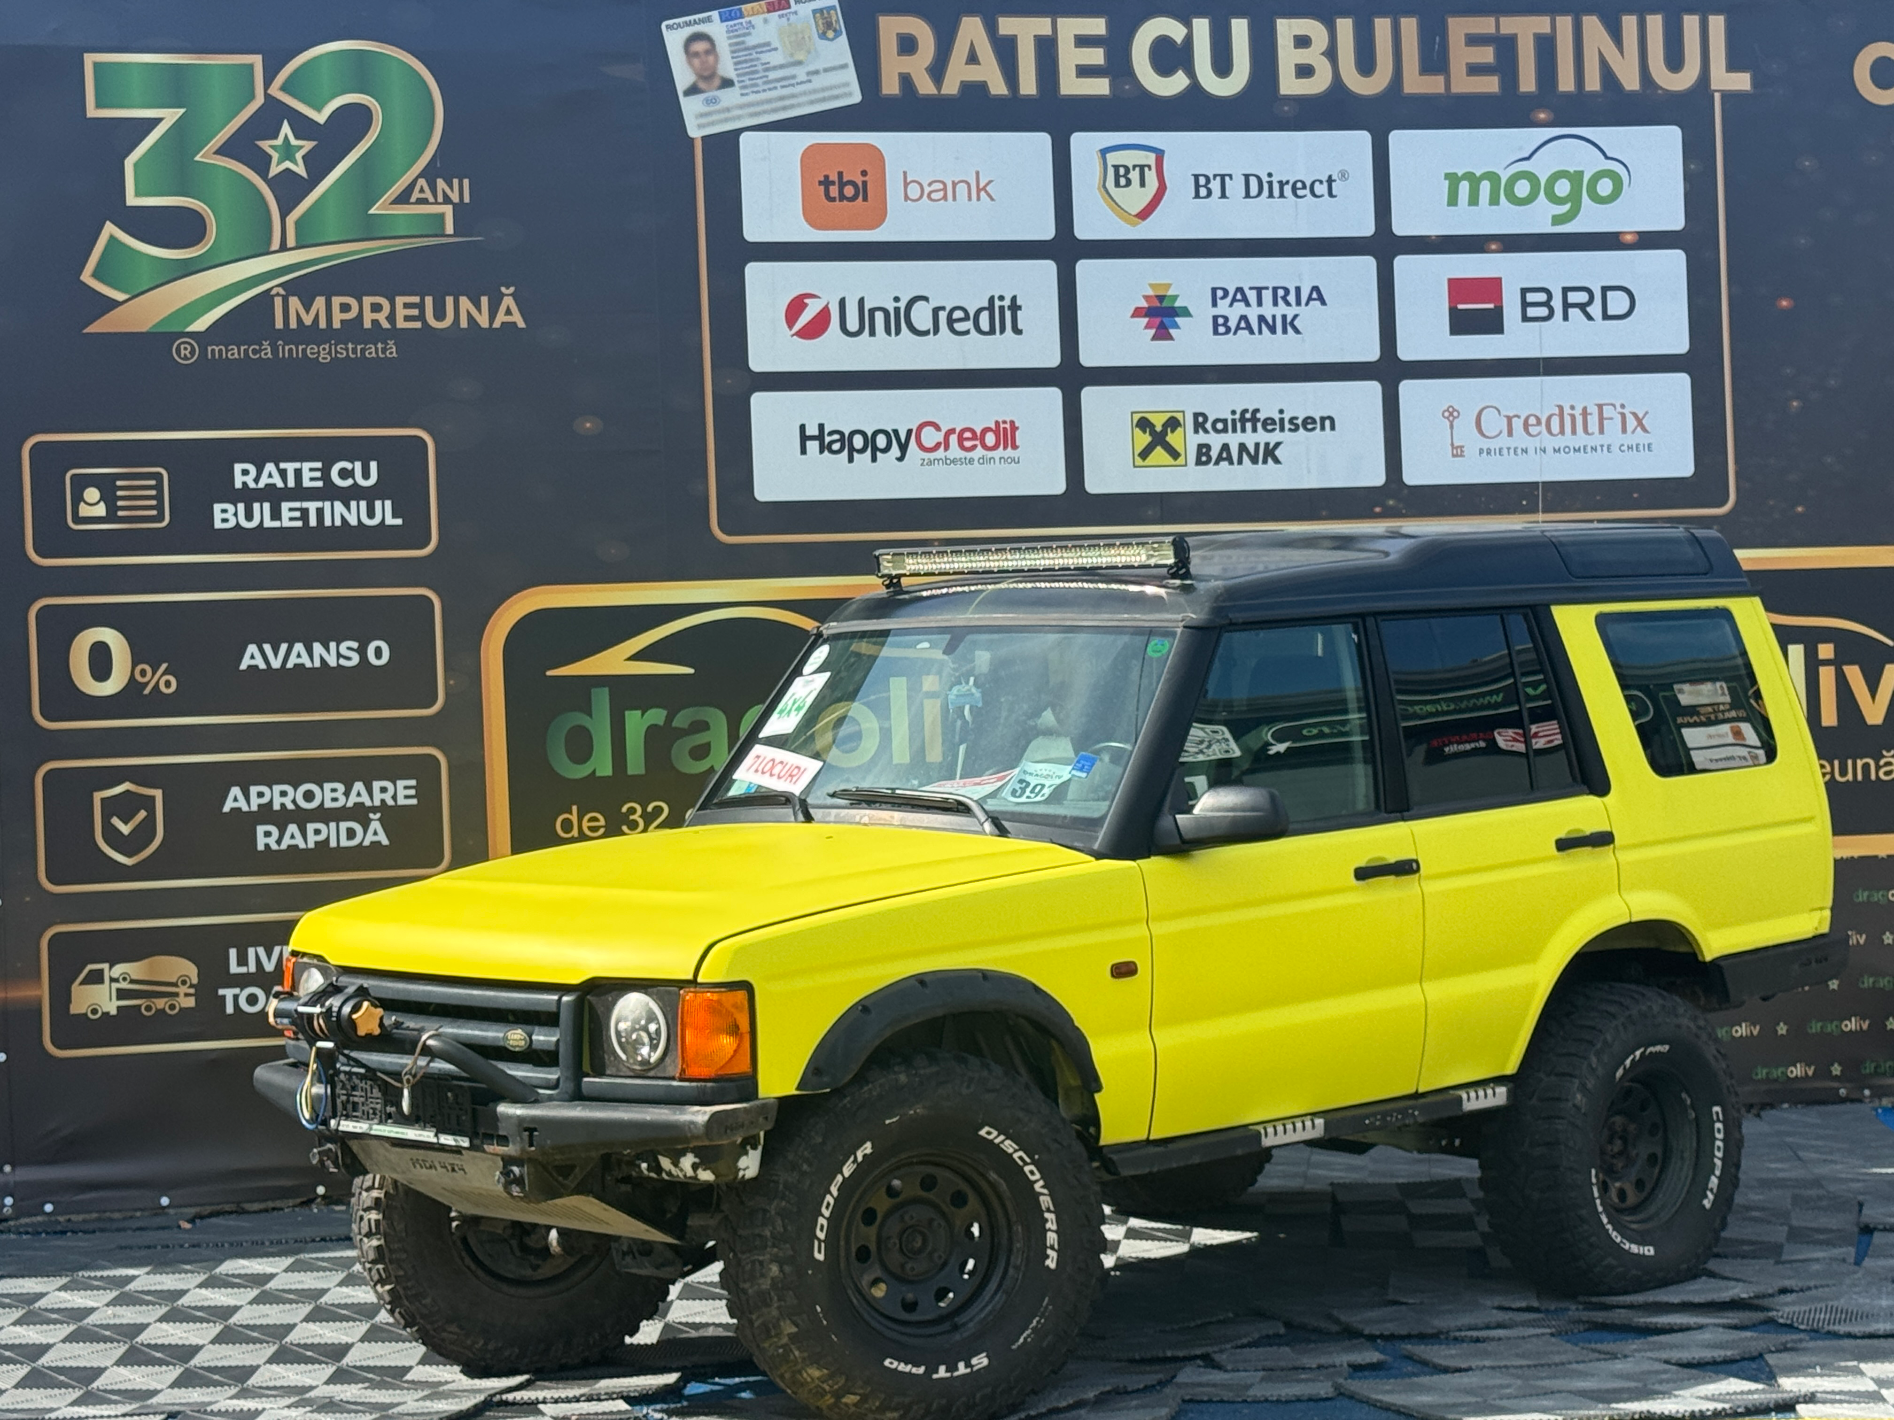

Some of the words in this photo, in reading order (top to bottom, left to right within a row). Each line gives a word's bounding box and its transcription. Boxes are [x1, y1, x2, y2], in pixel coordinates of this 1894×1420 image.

[665, 15, 714, 32] ROUMANIE
[877, 15, 1111, 97] RATE
[1131, 15, 1251, 97] CU
[1276, 13, 1752, 96] BULETINUL
[1853, 41, 1894, 106] C
[409, 177, 471, 204] ANI
[817, 169, 869, 203] tbi
[902, 169, 997, 203] bank
[1111, 164, 1152, 189] BT
[1191, 173, 1234, 200] BT
[1443, 167, 1625, 227] mogo
[270, 286, 526, 331] ÎMPREUNĂ
[1210, 285, 1328, 308] PATRIA
[1519, 284, 1637, 324] BRD
[838, 294, 1024, 339] UniCredit
[1212, 313, 1304, 336] BANK
[206, 340, 272, 361] marcă
[277, 338, 398, 363] înregistrată
[1192, 407, 1336, 435] Raiffeisen
[1474, 402, 1651, 440] CreditFix
[799, 419, 1020, 464] HappyCredit
[1194, 441, 1284, 467] BANK
[1478, 446, 1529, 458] PRIETEN
[1534, 446, 1547, 456] IN
[1552, 443, 1613, 456] MOMENTE
[1618, 442, 1654, 454] CHEIE
[233, 462, 323, 489] RATE
[330, 461, 379, 488] CU
[919, 455, 975, 467] zambeste
[977, 453, 996, 466] din
[998, 455, 1021, 465] nou
[212, 500, 403, 530] BULETINUL
[239, 641, 360, 671] AVANS
[366, 640, 391, 667] 0
[222, 779, 418, 813] APROBARE
[256, 811, 390, 851] RAPIDĂ
[555, 804, 606, 838] de
[620, 800, 670, 834] 32
[228, 945, 290, 975] LIV
[1858, 973, 1894, 990] drag
[1806, 1015, 1871, 1035] dragoliv
[1751, 1062, 1815, 1082] dragoliv
[1861, 1060, 1894, 1078] drag
[1702, 1104, 1725, 1211] COOPER
[814, 1140, 875, 1262] COOPER
[977, 1126, 1061, 1271] DISCOVERER
[883, 1357, 926, 1375] PRO
[931, 1351, 990, 1379] STT
